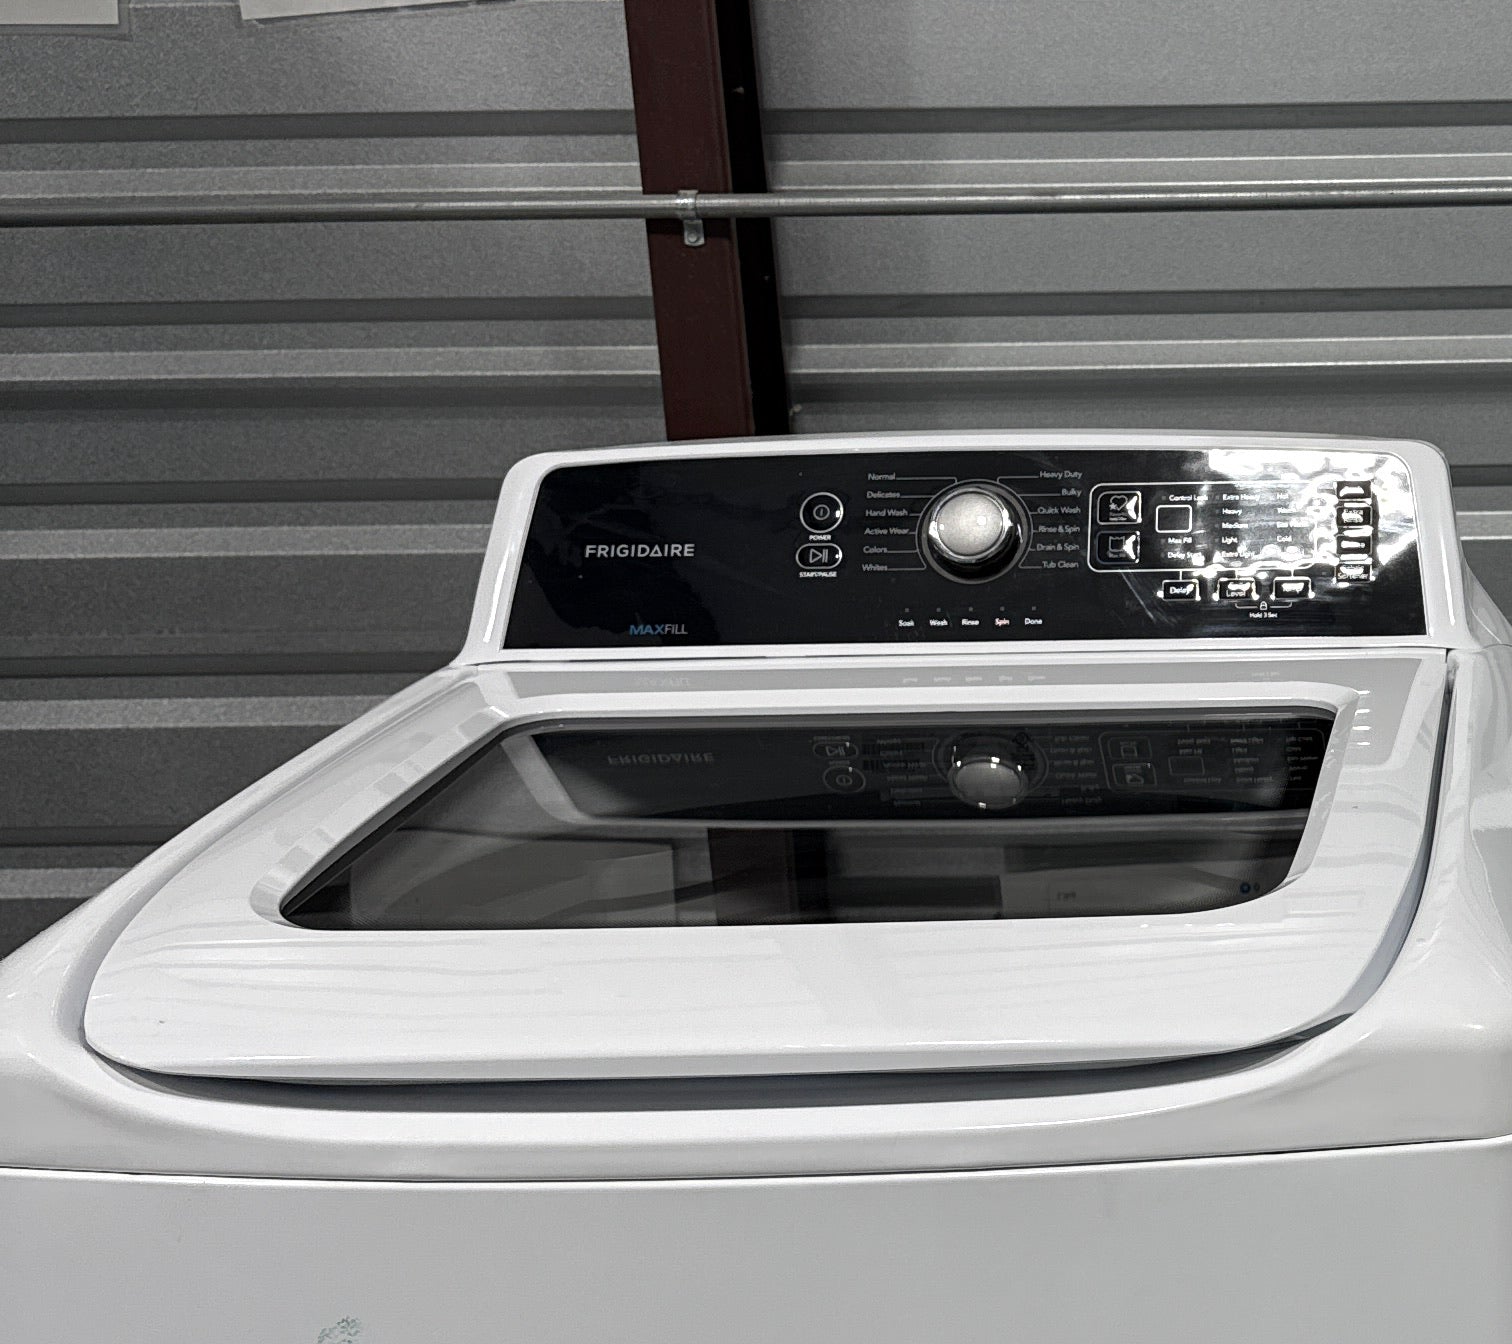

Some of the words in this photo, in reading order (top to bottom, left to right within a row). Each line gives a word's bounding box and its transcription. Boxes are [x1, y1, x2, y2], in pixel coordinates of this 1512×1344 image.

[868, 472, 896, 481] Normal
[1040, 470, 1061, 480] Heavy
[1063, 470, 1082, 480] Duty
[867, 491, 900, 499] Delicates
[1061, 488, 1082, 498] Bulky
[866, 508, 885, 517] Hand
[887, 508, 908, 517] Wash
[1037, 506, 1059, 515] Quick
[1059, 506, 1081, 514] Wash
[864, 527, 887, 535] Active
[888, 527, 909, 535] Wear
[1038, 525, 1057, 533] Rinse
[1064, 524, 1080, 534] Spin
[585, 543, 695, 558] FRIGIDAIRE
[863, 545, 887, 553] Colors
[862, 563, 888, 572] Whites
[1042, 560, 1056, 569] Tub
[1057, 560, 1079, 568] Clean
[629, 623, 688, 636] MAXFILL
